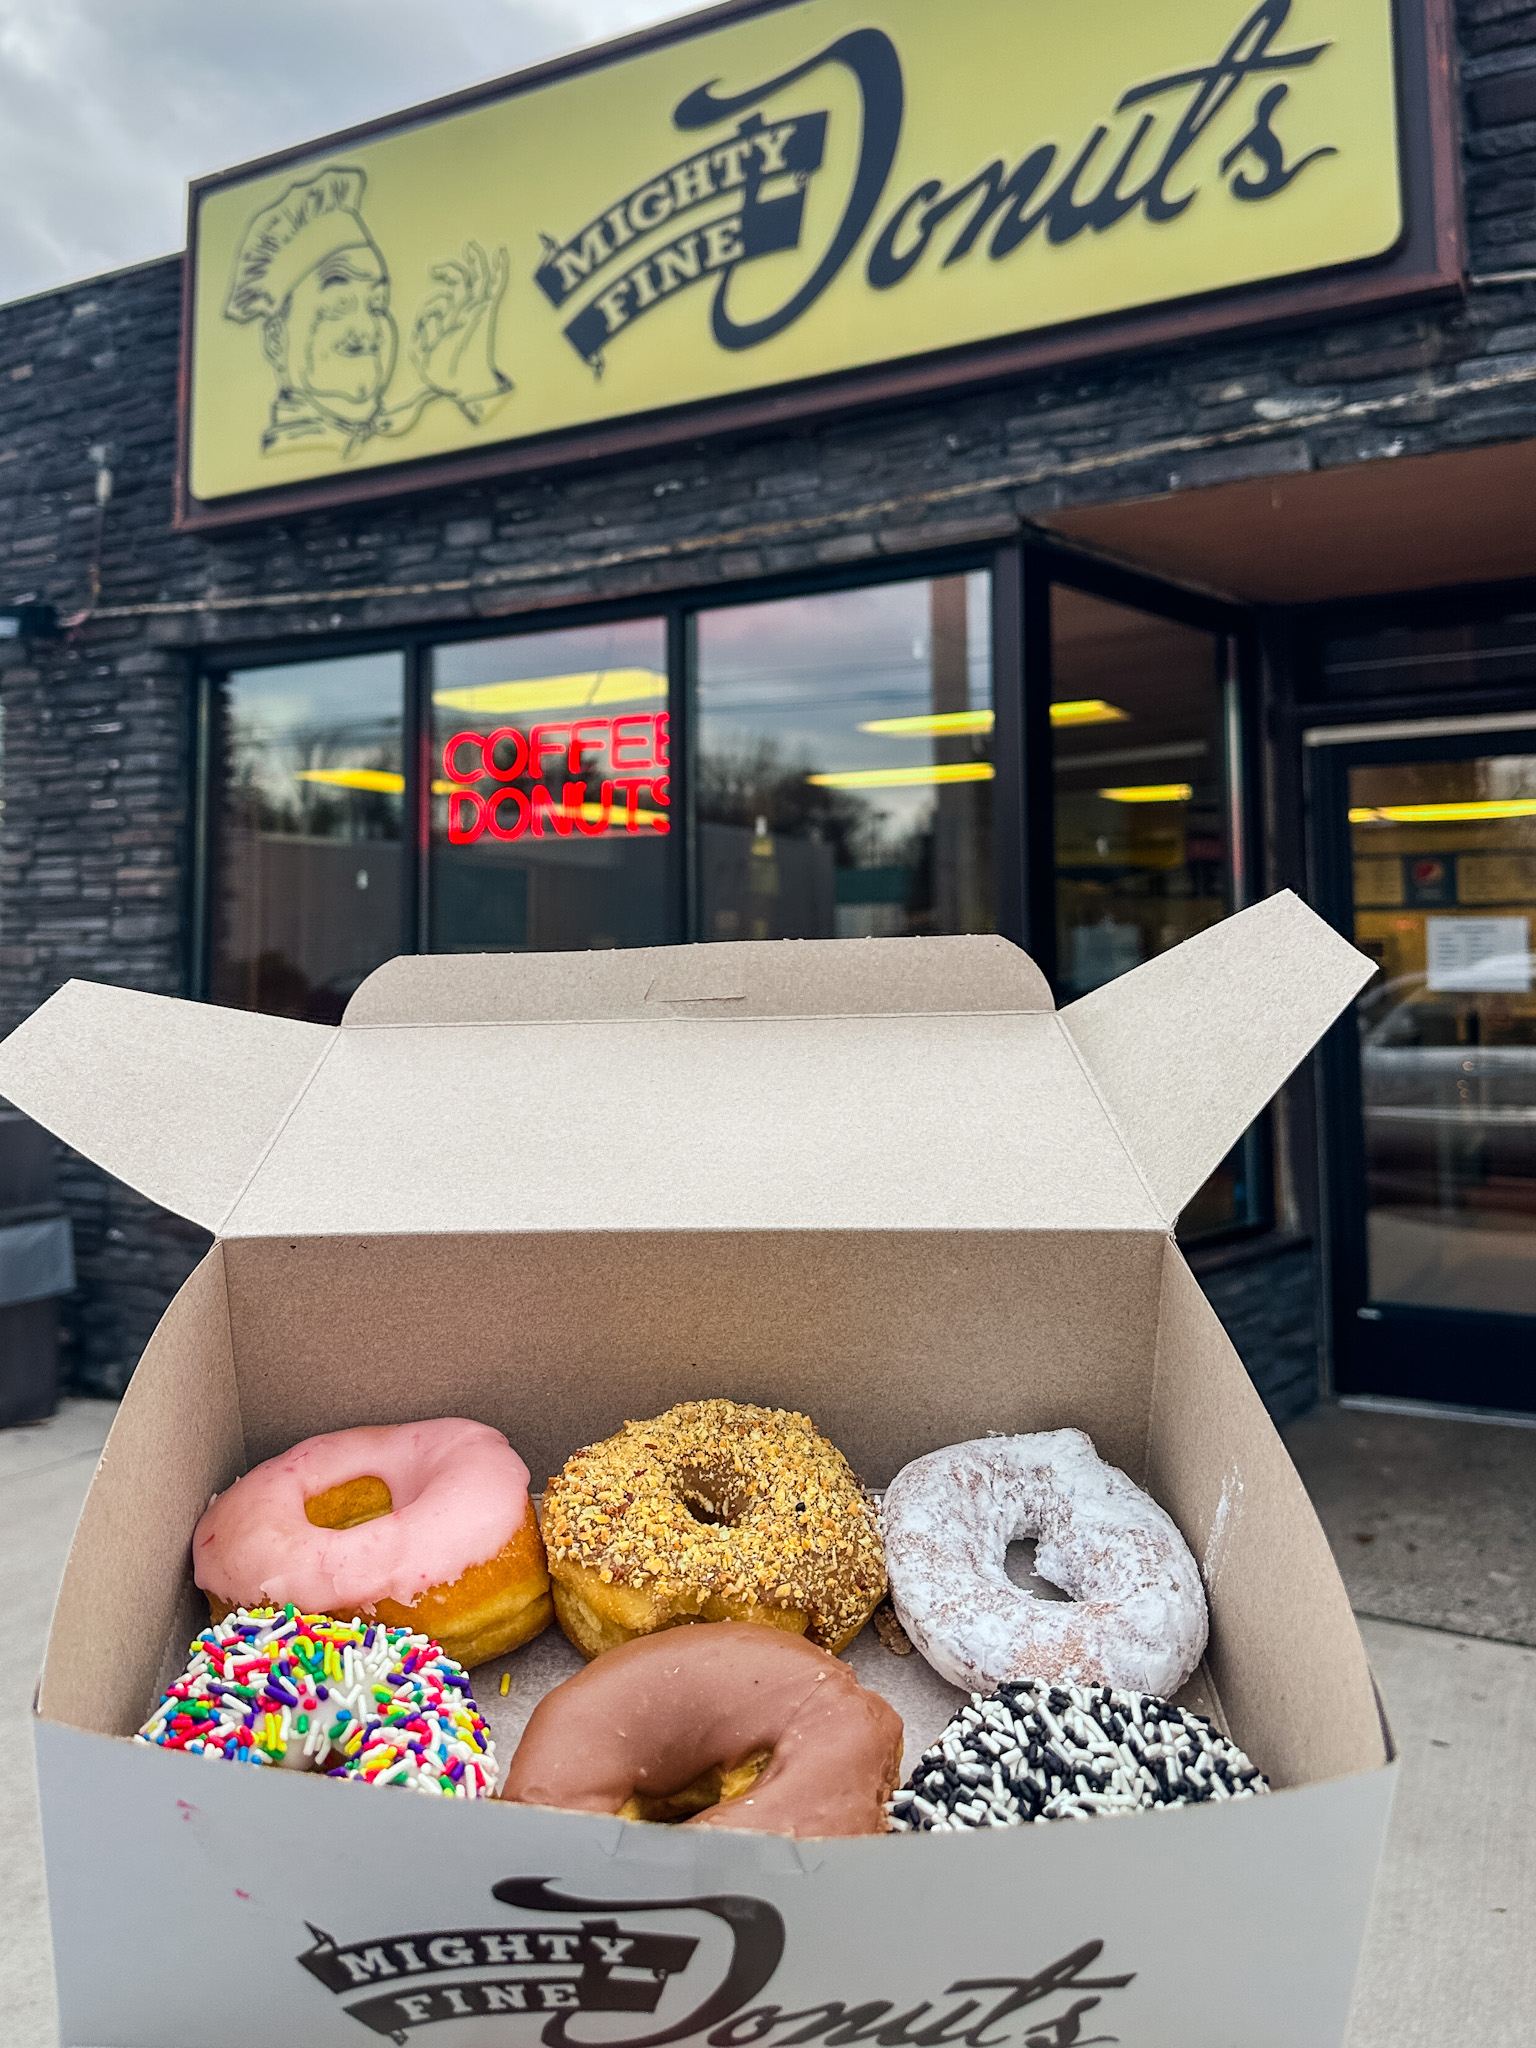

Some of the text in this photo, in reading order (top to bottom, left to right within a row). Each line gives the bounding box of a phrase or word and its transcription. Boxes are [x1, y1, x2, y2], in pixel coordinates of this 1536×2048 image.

[552, 123, 798, 293] MIGHTY
[594, 216, 746, 333] FINE
[338, 1934, 635, 1982] MIGHTY
[394, 1983, 581, 2021] FINE
